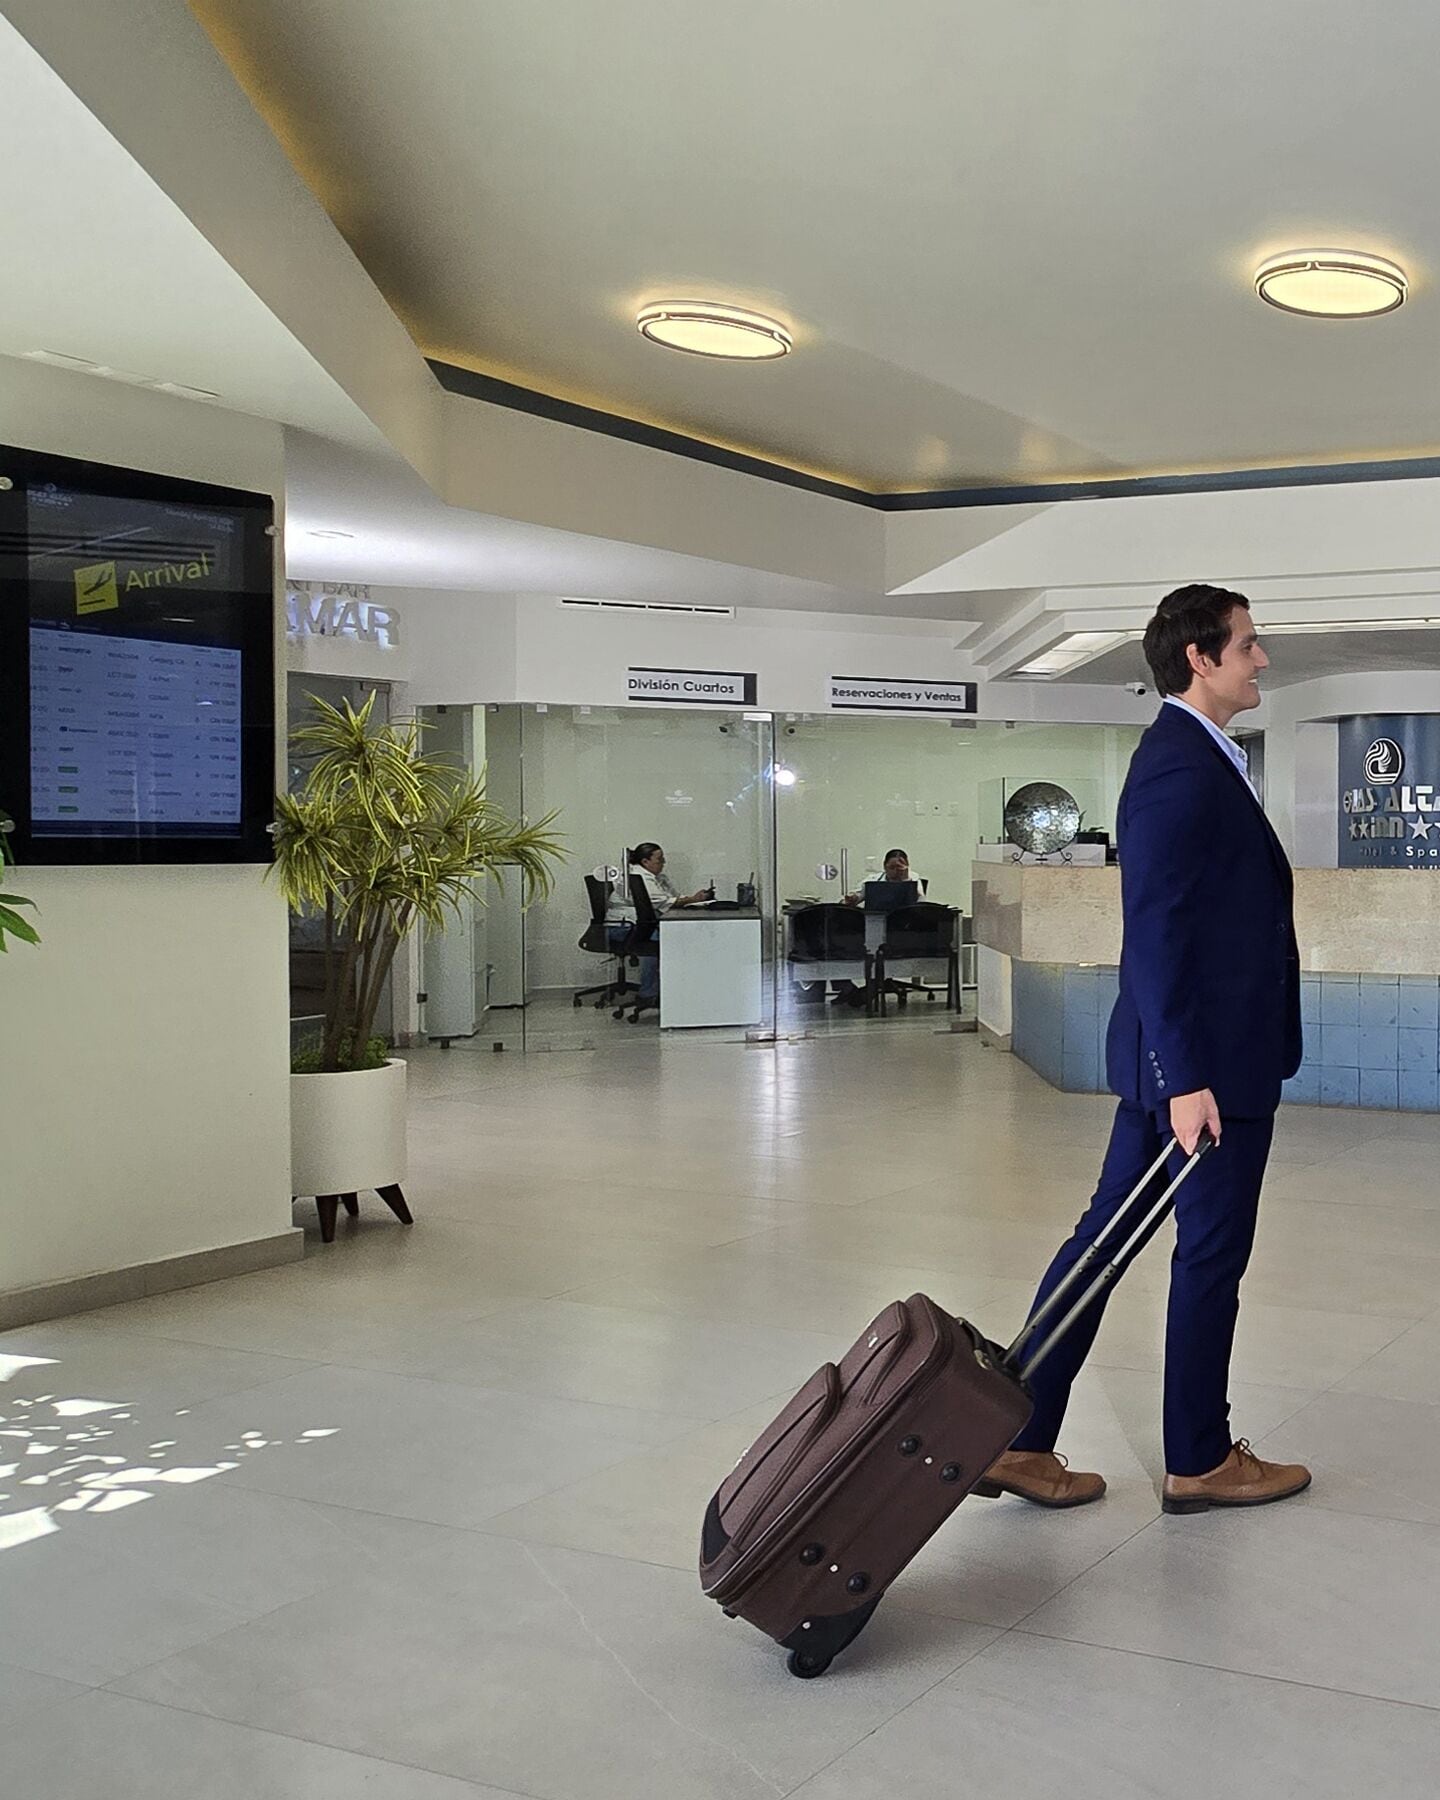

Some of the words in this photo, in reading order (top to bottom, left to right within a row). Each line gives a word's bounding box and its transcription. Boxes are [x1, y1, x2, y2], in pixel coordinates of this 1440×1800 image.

[125, 553, 210, 592] Arrival
[628, 678, 679, 691] División
[683, 681, 735, 694] Cuartos
[832, 687, 912, 700] Reservaciones
[915, 691, 922, 702] y
[924, 691, 962, 702] Ventas
[1405, 845, 1438, 858] Spa
